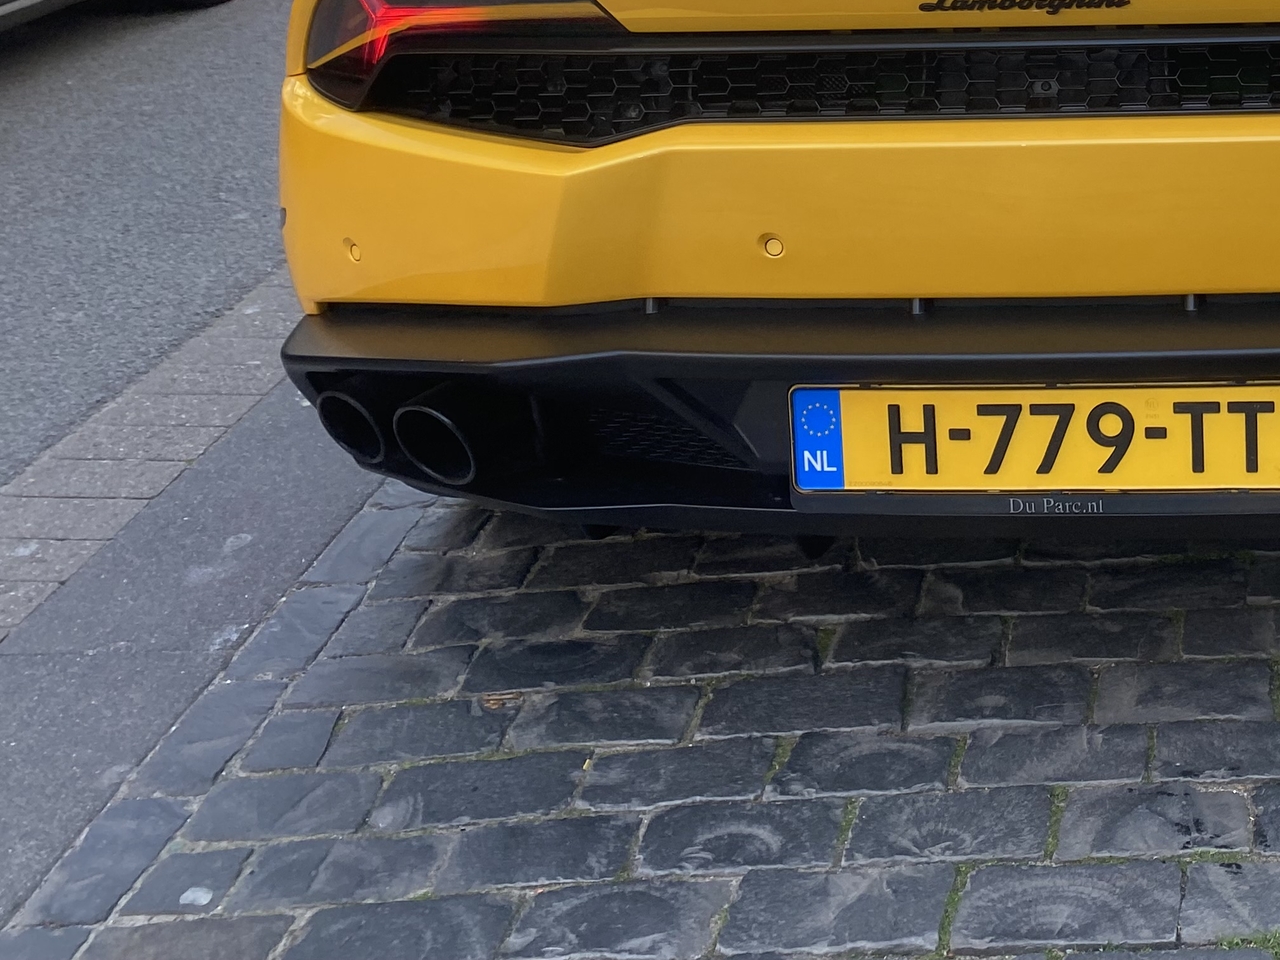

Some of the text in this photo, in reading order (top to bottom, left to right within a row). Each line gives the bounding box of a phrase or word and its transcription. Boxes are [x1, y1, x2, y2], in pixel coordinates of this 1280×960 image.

[886, 400, 1276, 476] H-779-TT
[803, 449, 838, 473] NL
[1009, 497, 1104, 514] Du Parc.nl
